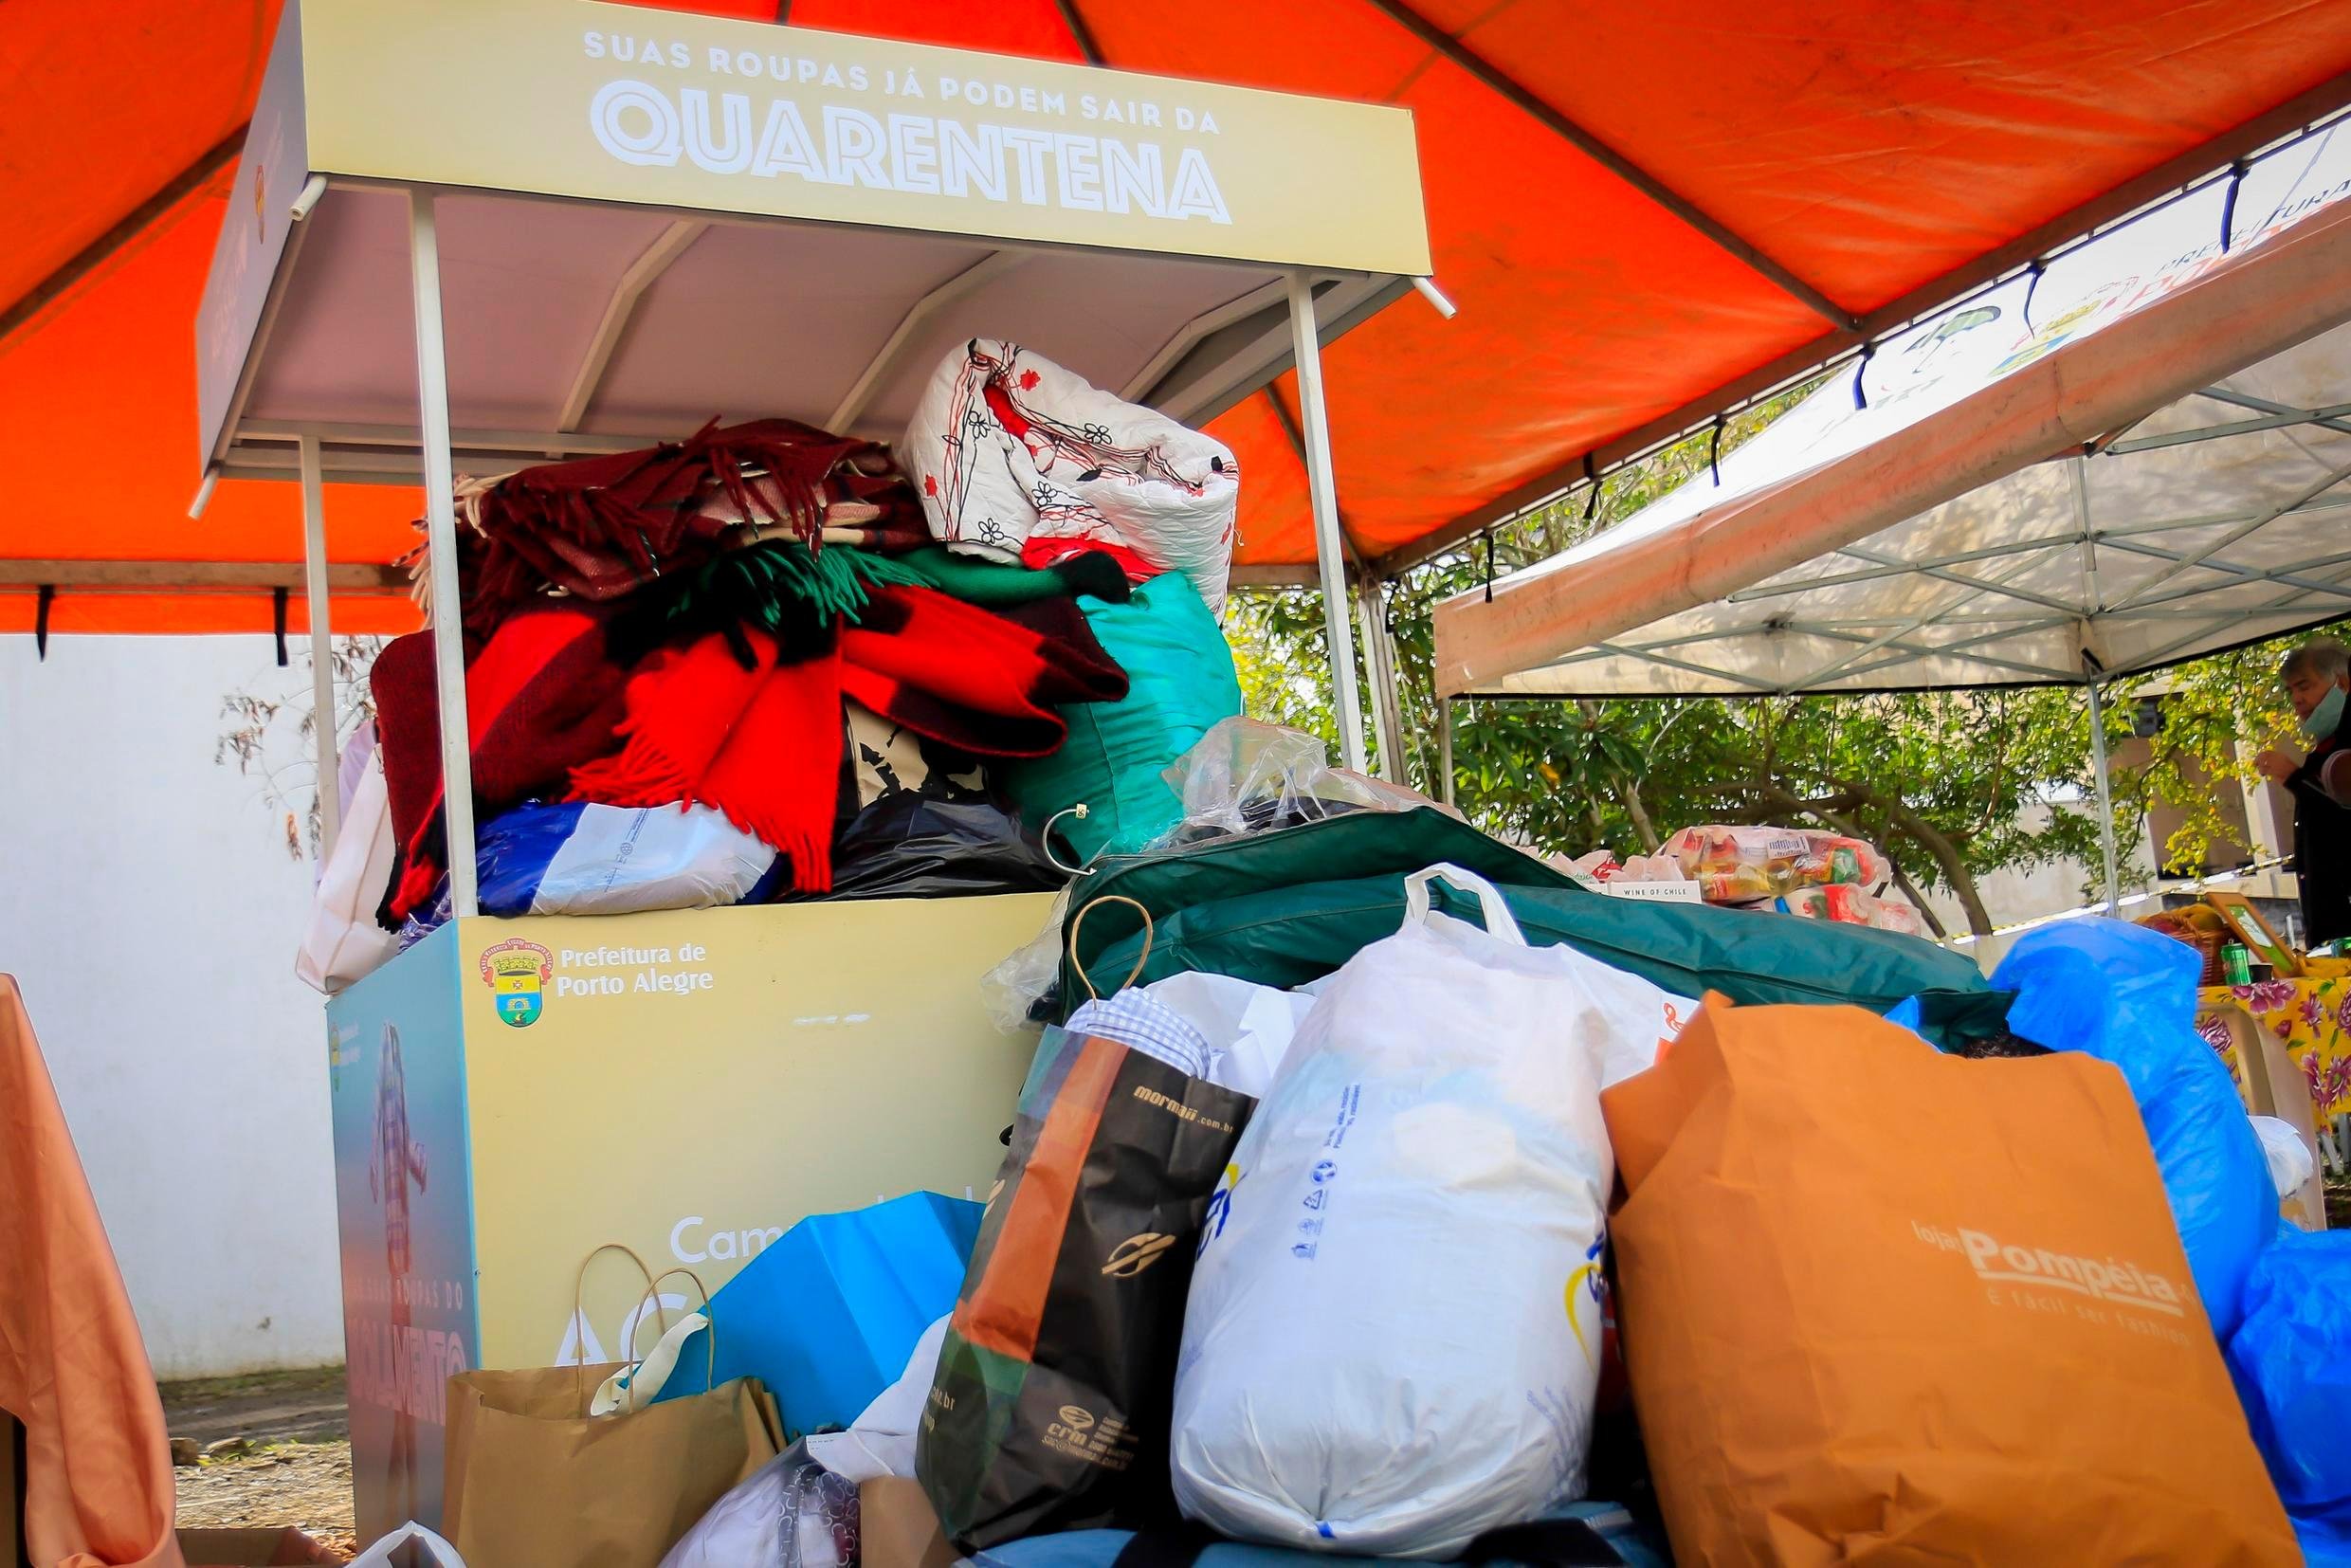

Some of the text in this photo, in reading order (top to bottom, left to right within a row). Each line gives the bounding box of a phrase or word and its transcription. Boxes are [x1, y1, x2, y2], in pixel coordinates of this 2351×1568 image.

[584, 31, 1220, 135] SUAS ROUPAS JÁ PODEM SAIR DA
[590, 80, 1232, 226] QUARENTENA
[556, 968, 714, 997] Porto Alegre
[561, 946, 671, 968] Prefeitura
[679, 942, 706, 962] de
